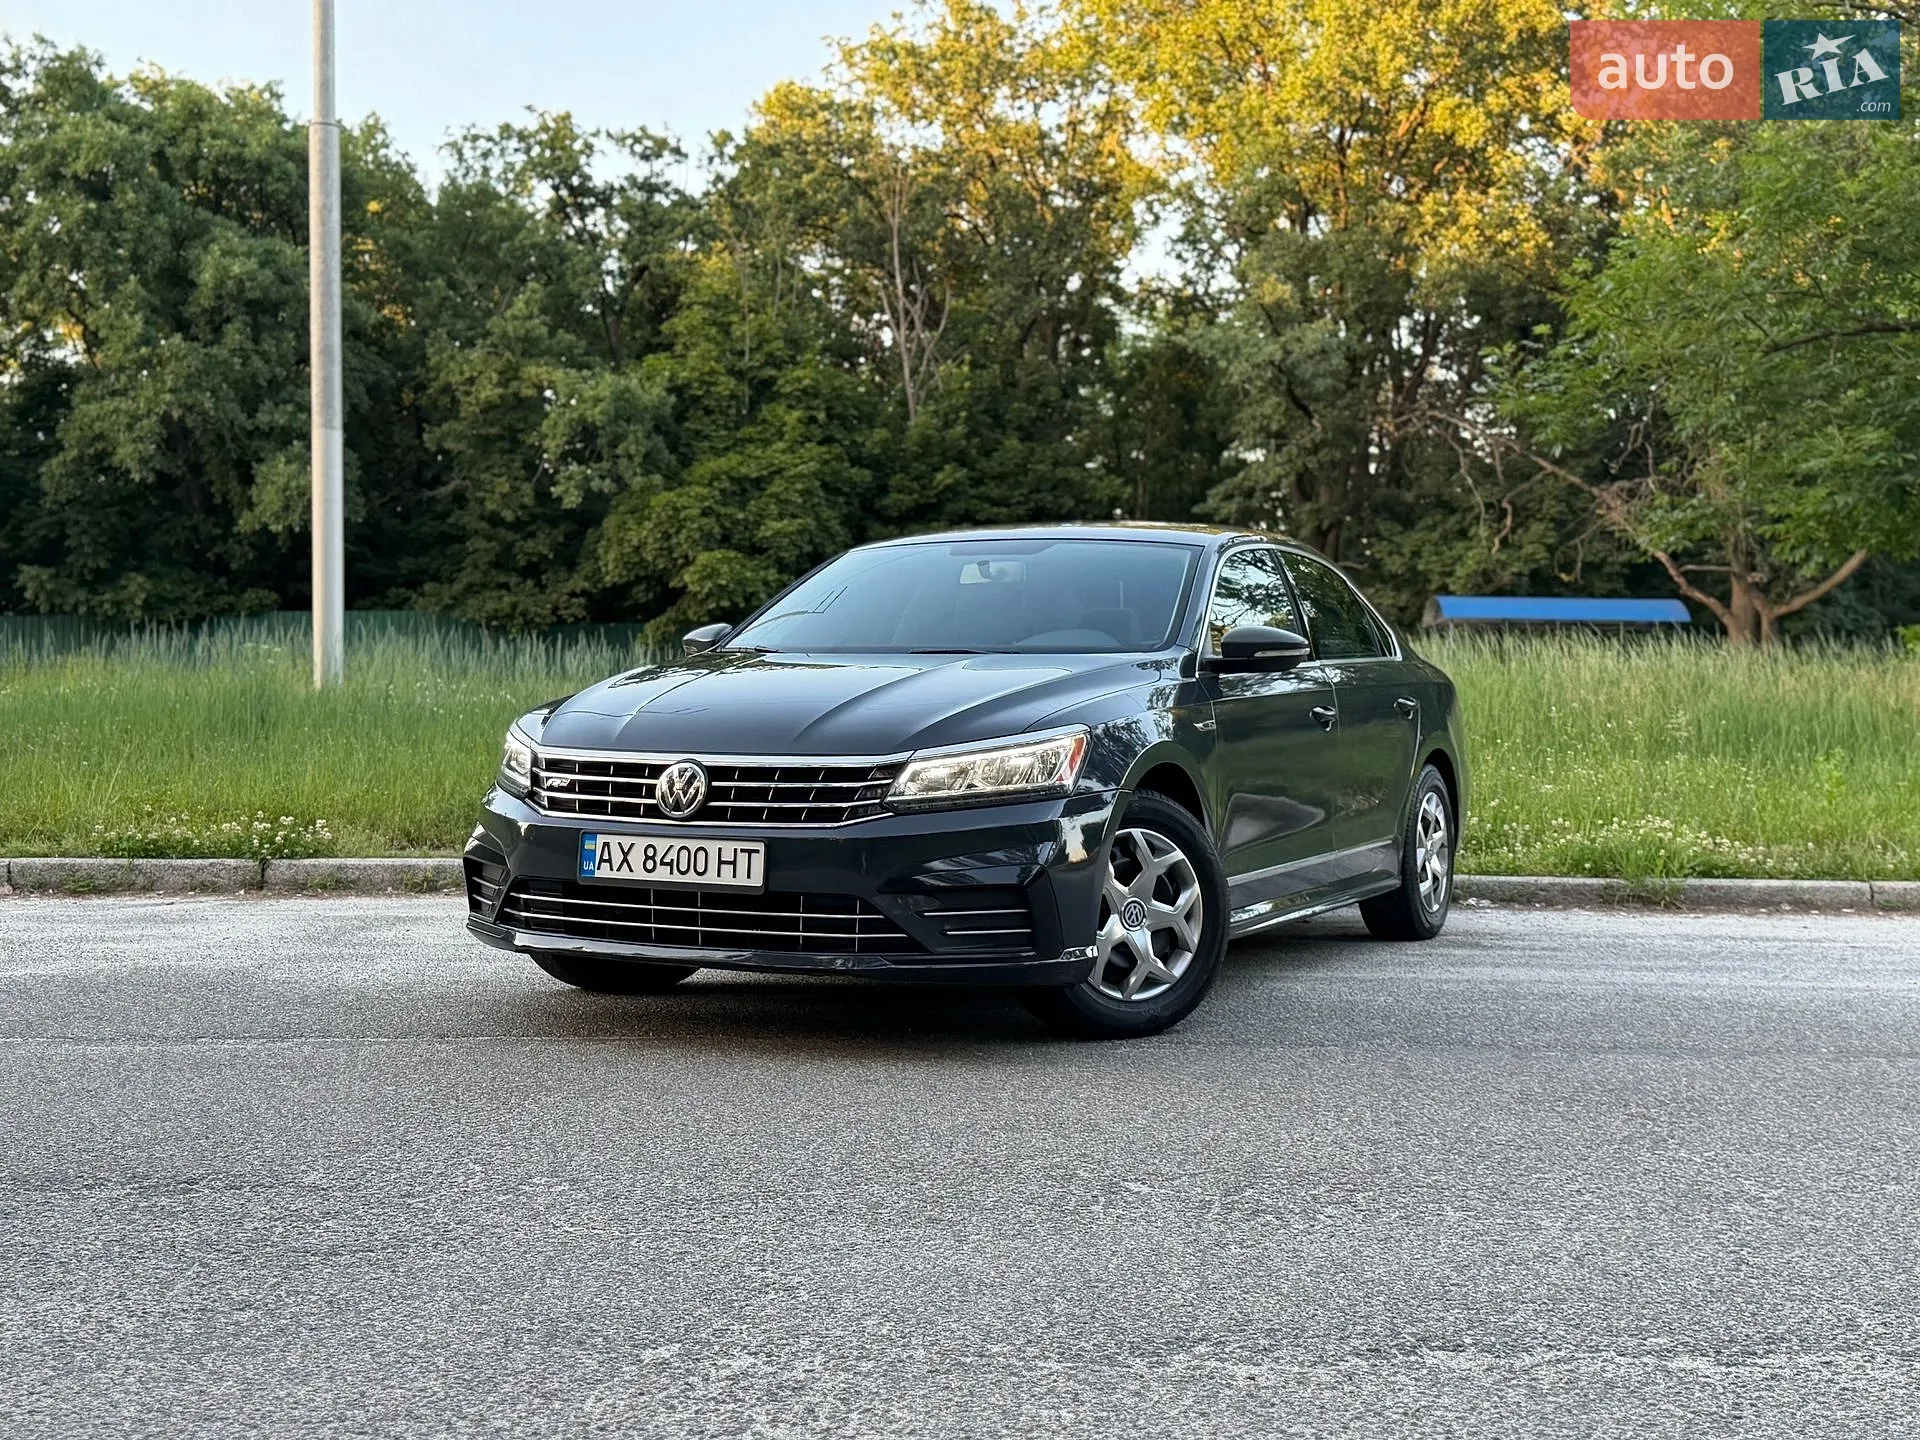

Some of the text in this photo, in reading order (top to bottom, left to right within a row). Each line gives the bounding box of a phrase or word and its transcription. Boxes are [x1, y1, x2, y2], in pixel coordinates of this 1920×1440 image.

[658, 762, 706, 815] VW
[583, 861, 594, 871] UA
[597, 841, 760, 879] AX 8400 HT
